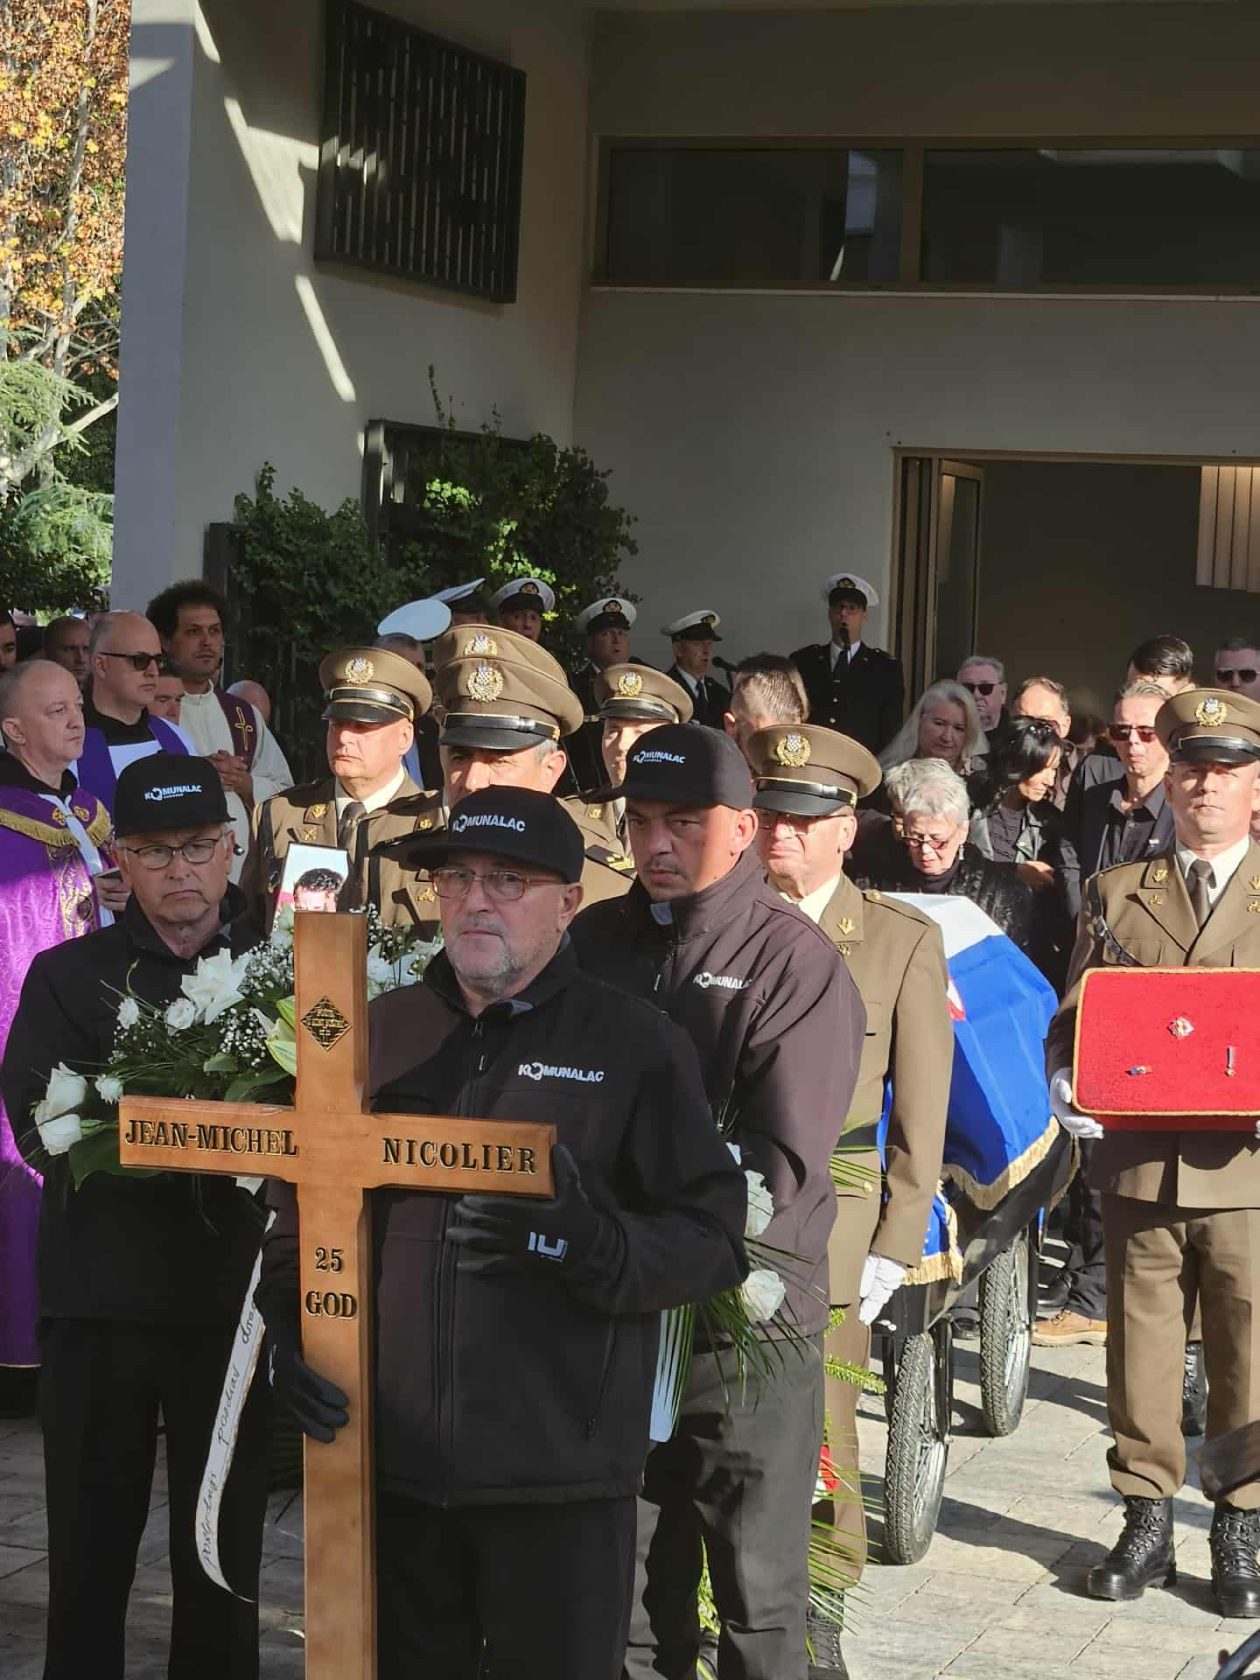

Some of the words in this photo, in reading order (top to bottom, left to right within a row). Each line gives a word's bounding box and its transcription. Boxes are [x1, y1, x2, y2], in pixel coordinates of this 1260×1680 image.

[144, 785, 203, 801] KOMUNALAC
[452, 814, 526, 833] KOMUNALAC
[518, 1062, 605, 1082] KOMUNALAC
[125, 1119, 299, 1157] JEAN-MICHEL
[382, 1137, 537, 1175] NICOLIER
[315, 1246, 344, 1273] 25
[305, 1290, 358, 1319] GOD
